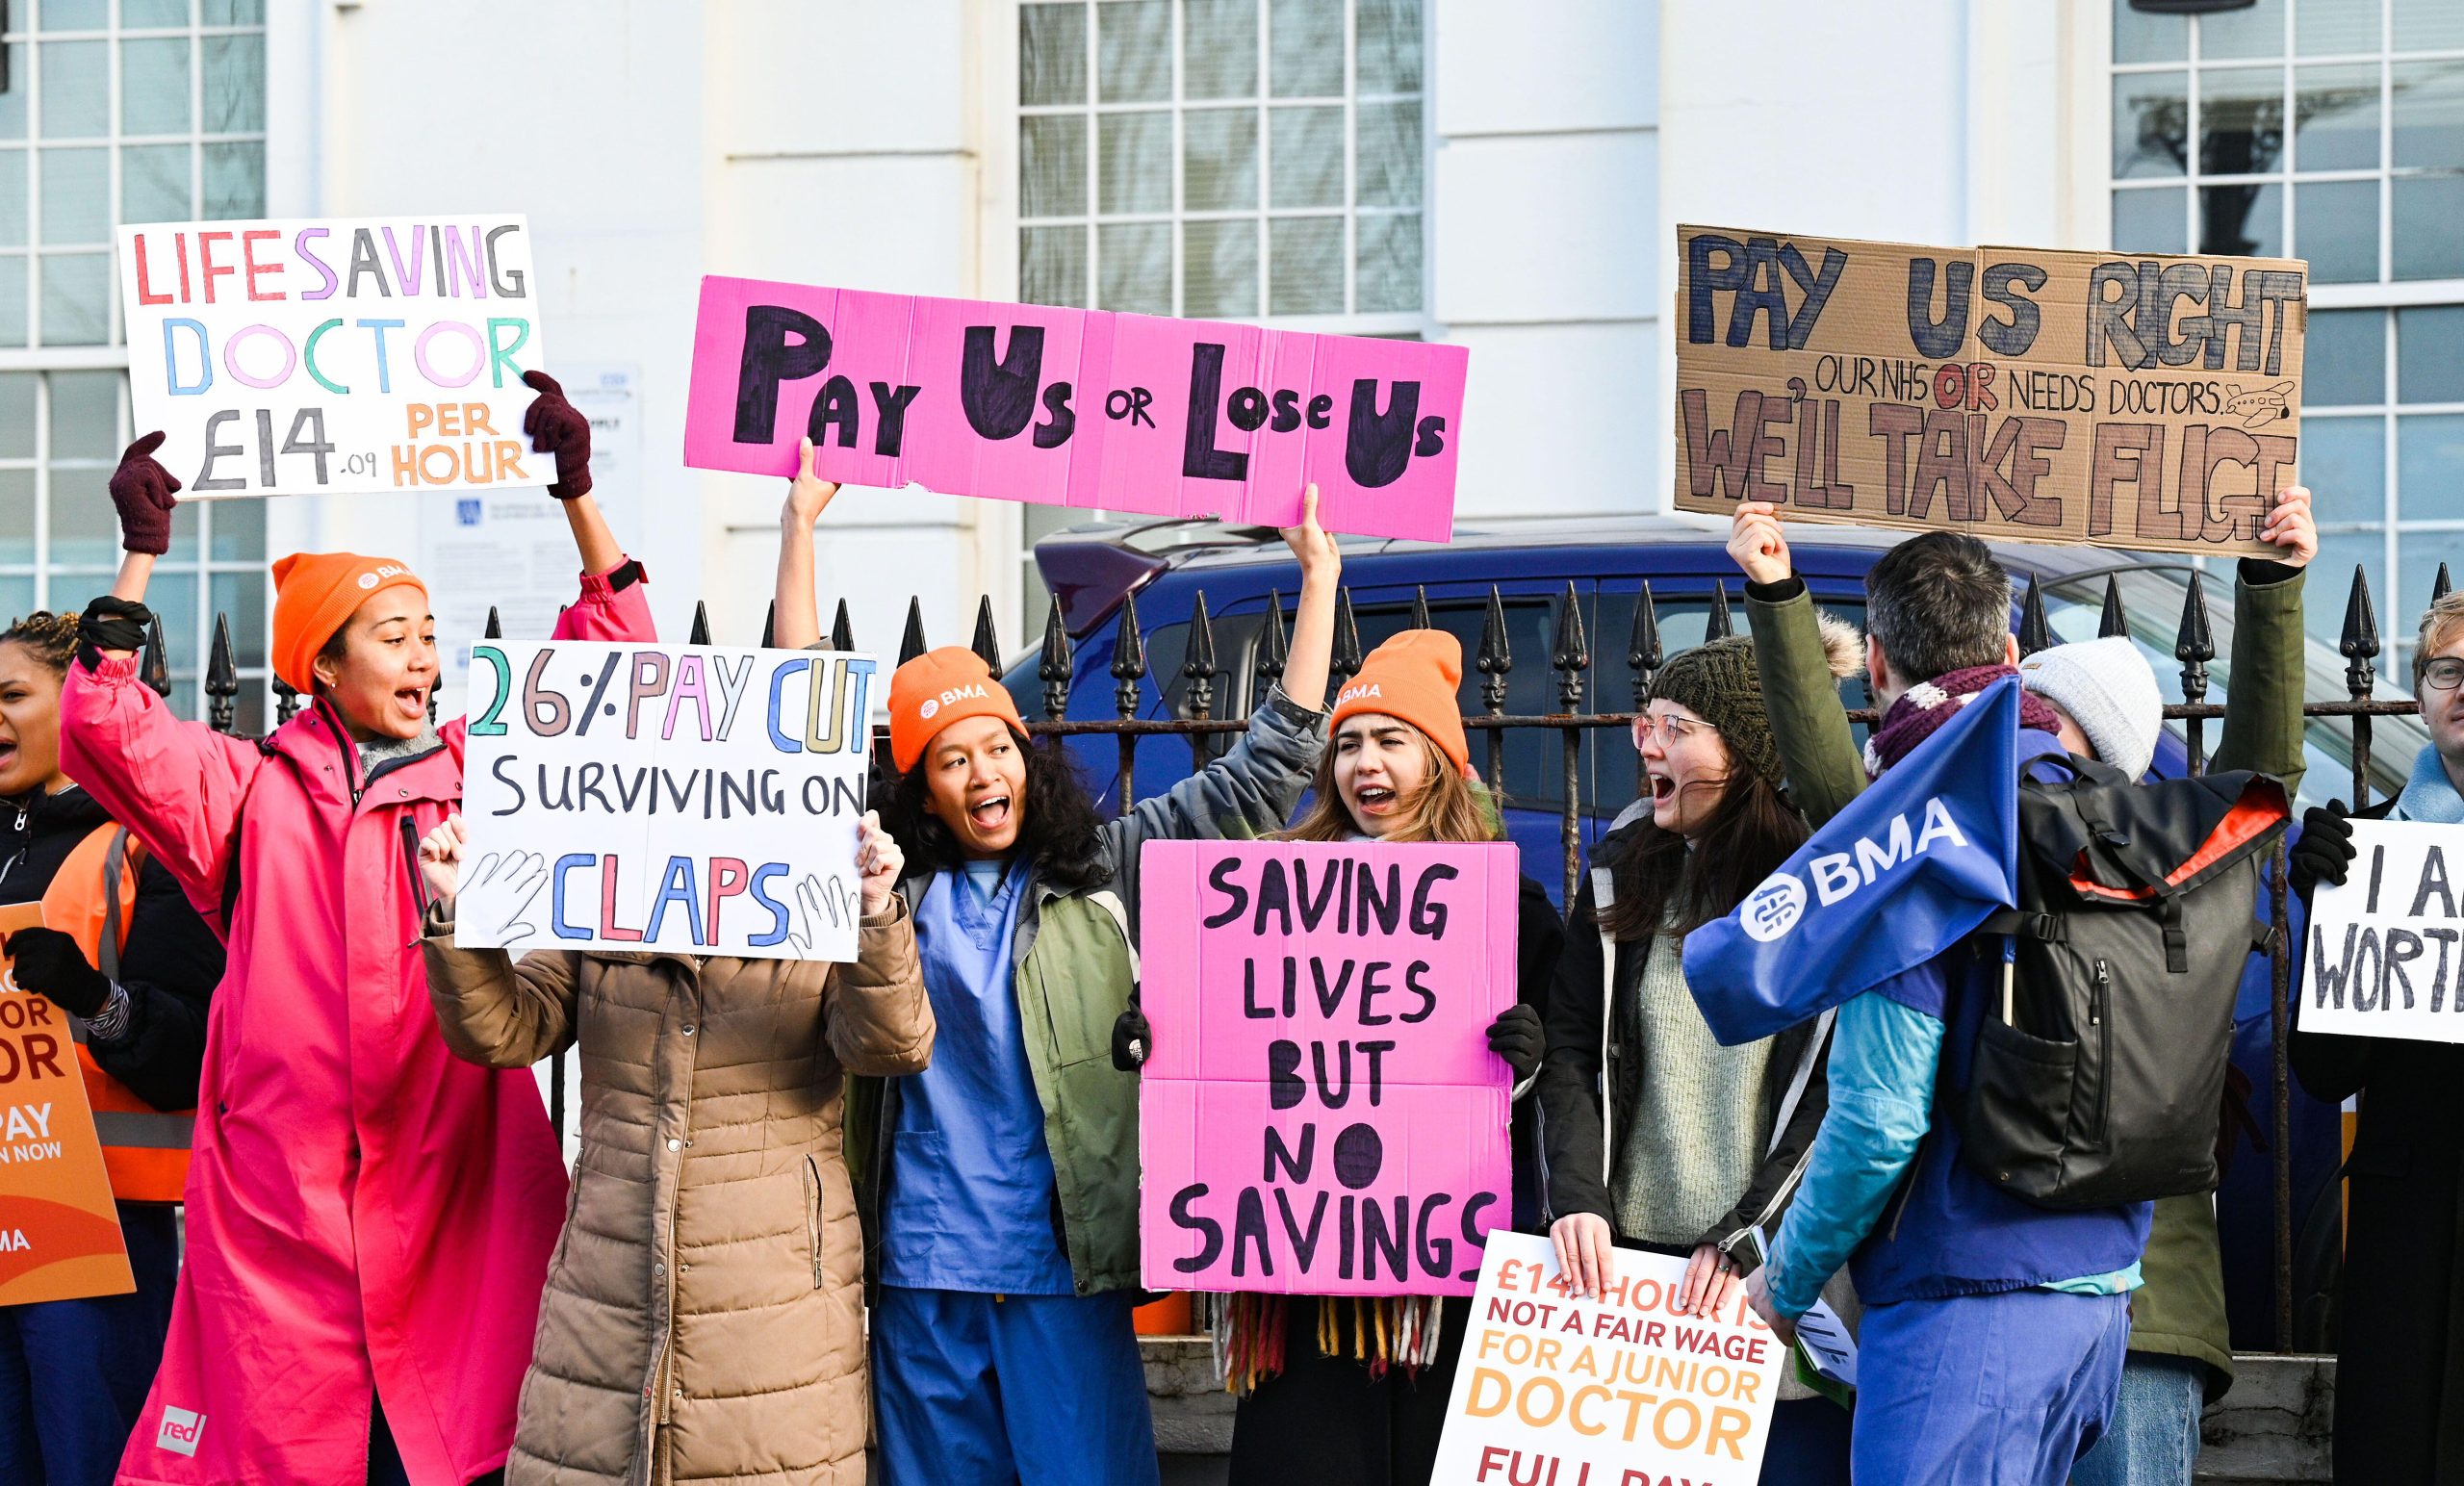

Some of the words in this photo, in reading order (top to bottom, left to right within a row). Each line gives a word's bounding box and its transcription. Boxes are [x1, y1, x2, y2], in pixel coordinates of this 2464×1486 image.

[1689, 235, 1848, 350] PAY
[1908, 258, 2047, 358] US
[2086, 262, 2302, 375] RIGHT
[163, 318, 529, 396] DOCTOR
[1816, 355, 1877, 397] OUR
[1883, 359, 1928, 400] NHS
[1934, 363, 1998, 411] OR
[2010, 370, 2094, 412] NEEDS
[2110, 380, 2224, 415] DOCTORS.
[406, 402, 500, 439] PER
[1105, 387, 1156, 428] OR
[391, 440, 529, 486] HOUR
[1681, 377, 1853, 509] WE'LL
[1870, 403, 2066, 526] TAKE
[626, 652, 755, 742] PAY
[767, 658, 877, 754] CUT
[940, 684, 989, 705] BMA
[1342, 683, 1382, 705] BMA
[492, 755, 784, 819] SURVIVING
[802, 773, 864, 817] ON
[1809, 796, 1968, 908] BMA
[2366, 844, 2384, 913] I
[2407, 845, 2464, 917] A
[552, 854, 789, 947] CLAPS
[1203, 857, 1459, 940] SAVING
[1244, 956, 1436, 1026] LIVES
[1268, 1039, 1396, 1110] BUT
[0, 1102, 52, 1141] AY
[13, 1141, 61, 1163] NOW
[1264, 1122, 1383, 1190] NO
[1168, 1183, 1498, 1282] SAVINGS
[1486, 1296, 1558, 1329] NOT
[1560, 1309, 1584, 1335] A
[1593, 1313, 1666, 1348] FAIR
[1675, 1325, 1768, 1365] WAGE
[1477, 1329, 1563, 1371] FOR
[1567, 1345, 1599, 1377] A
[1604, 1349, 1761, 1404] JUNIOR
[164, 1413, 203, 1443] red
[1465, 1366, 1752, 1462] DOCTOR
